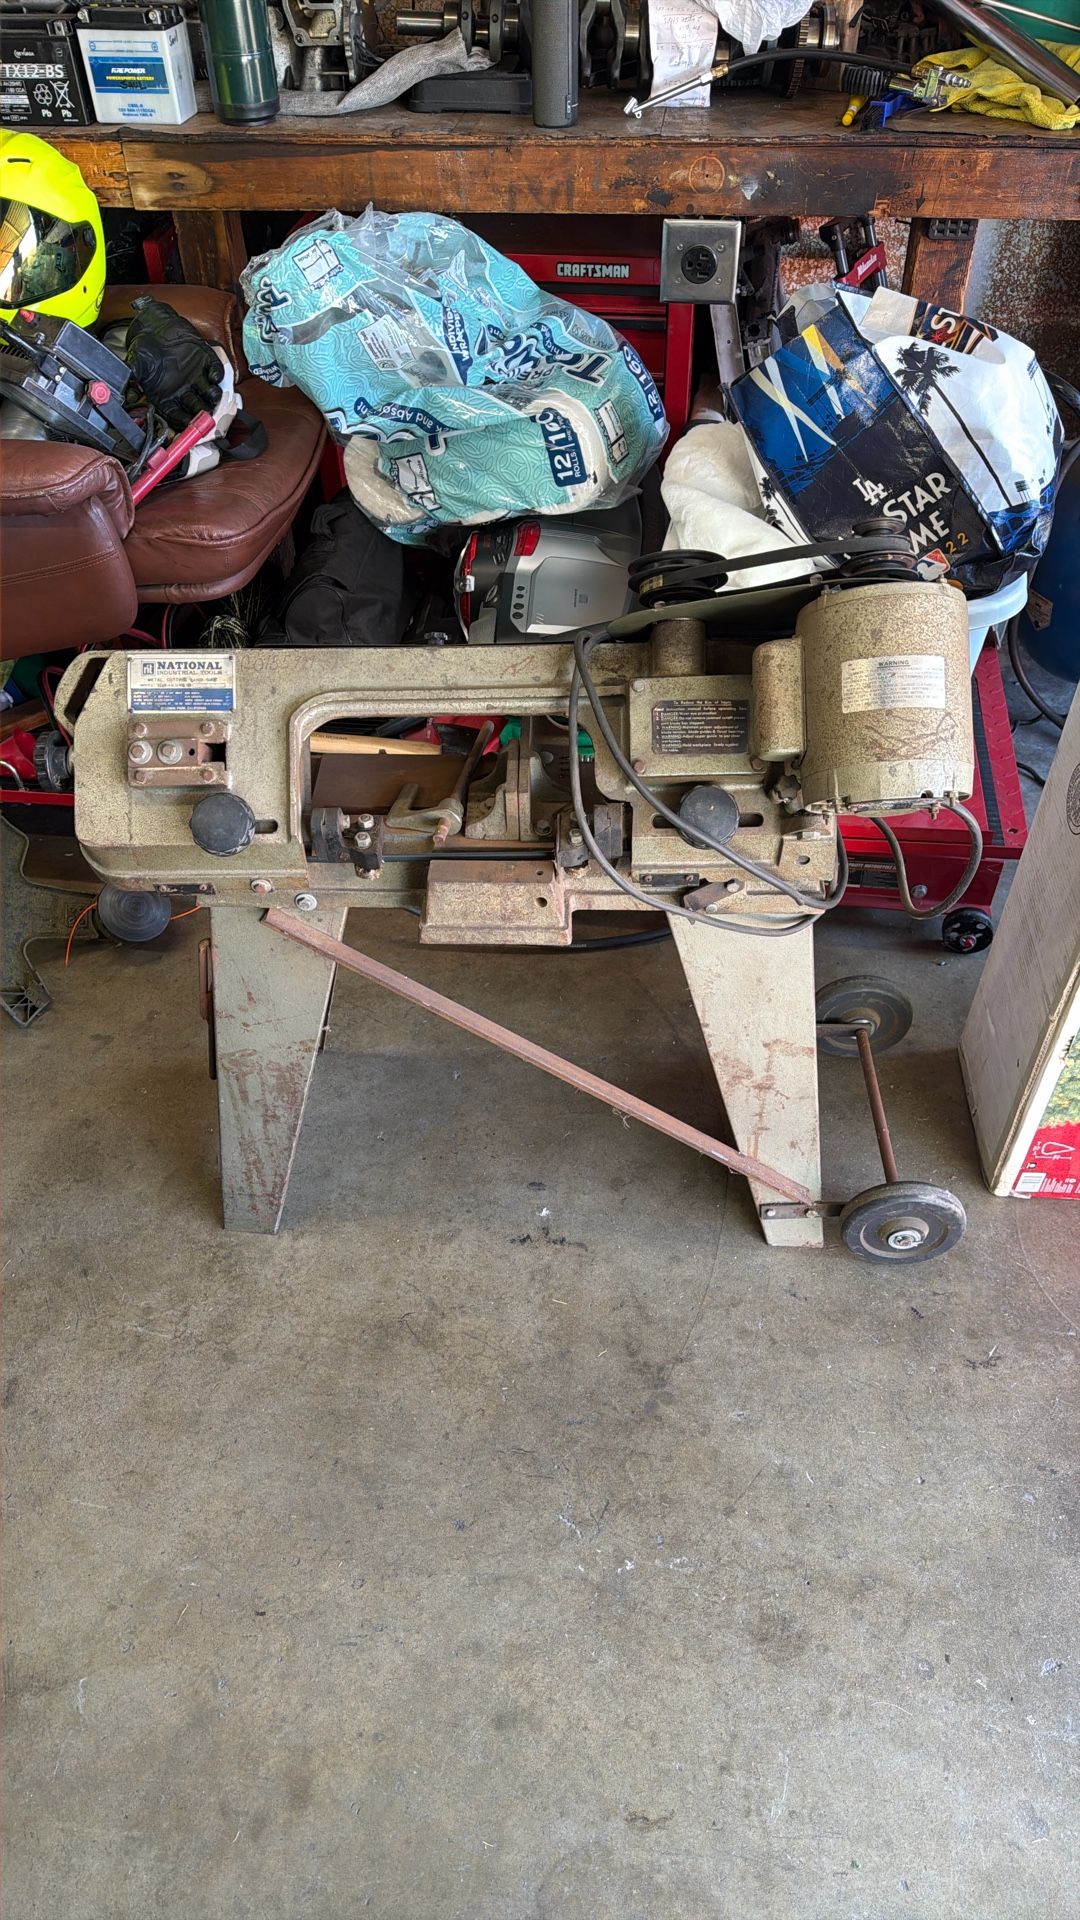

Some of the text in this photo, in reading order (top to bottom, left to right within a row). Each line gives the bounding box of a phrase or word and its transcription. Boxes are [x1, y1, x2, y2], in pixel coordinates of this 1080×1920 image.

[41, 109, 52, 118] Pb
[61, 109, 72, 118] Pb
[556, 263, 630, 279] CRAFTSMAN
[415, 412, 434, 429] and
[549, 452, 575, 482] 12
[567, 449, 583, 478] ROLLS
[852, 478, 889, 507] LA
[882, 472, 953, 525] STAR
[157, 661, 223, 670] NATIONAL
[878, 659, 910, 667] WARNING
